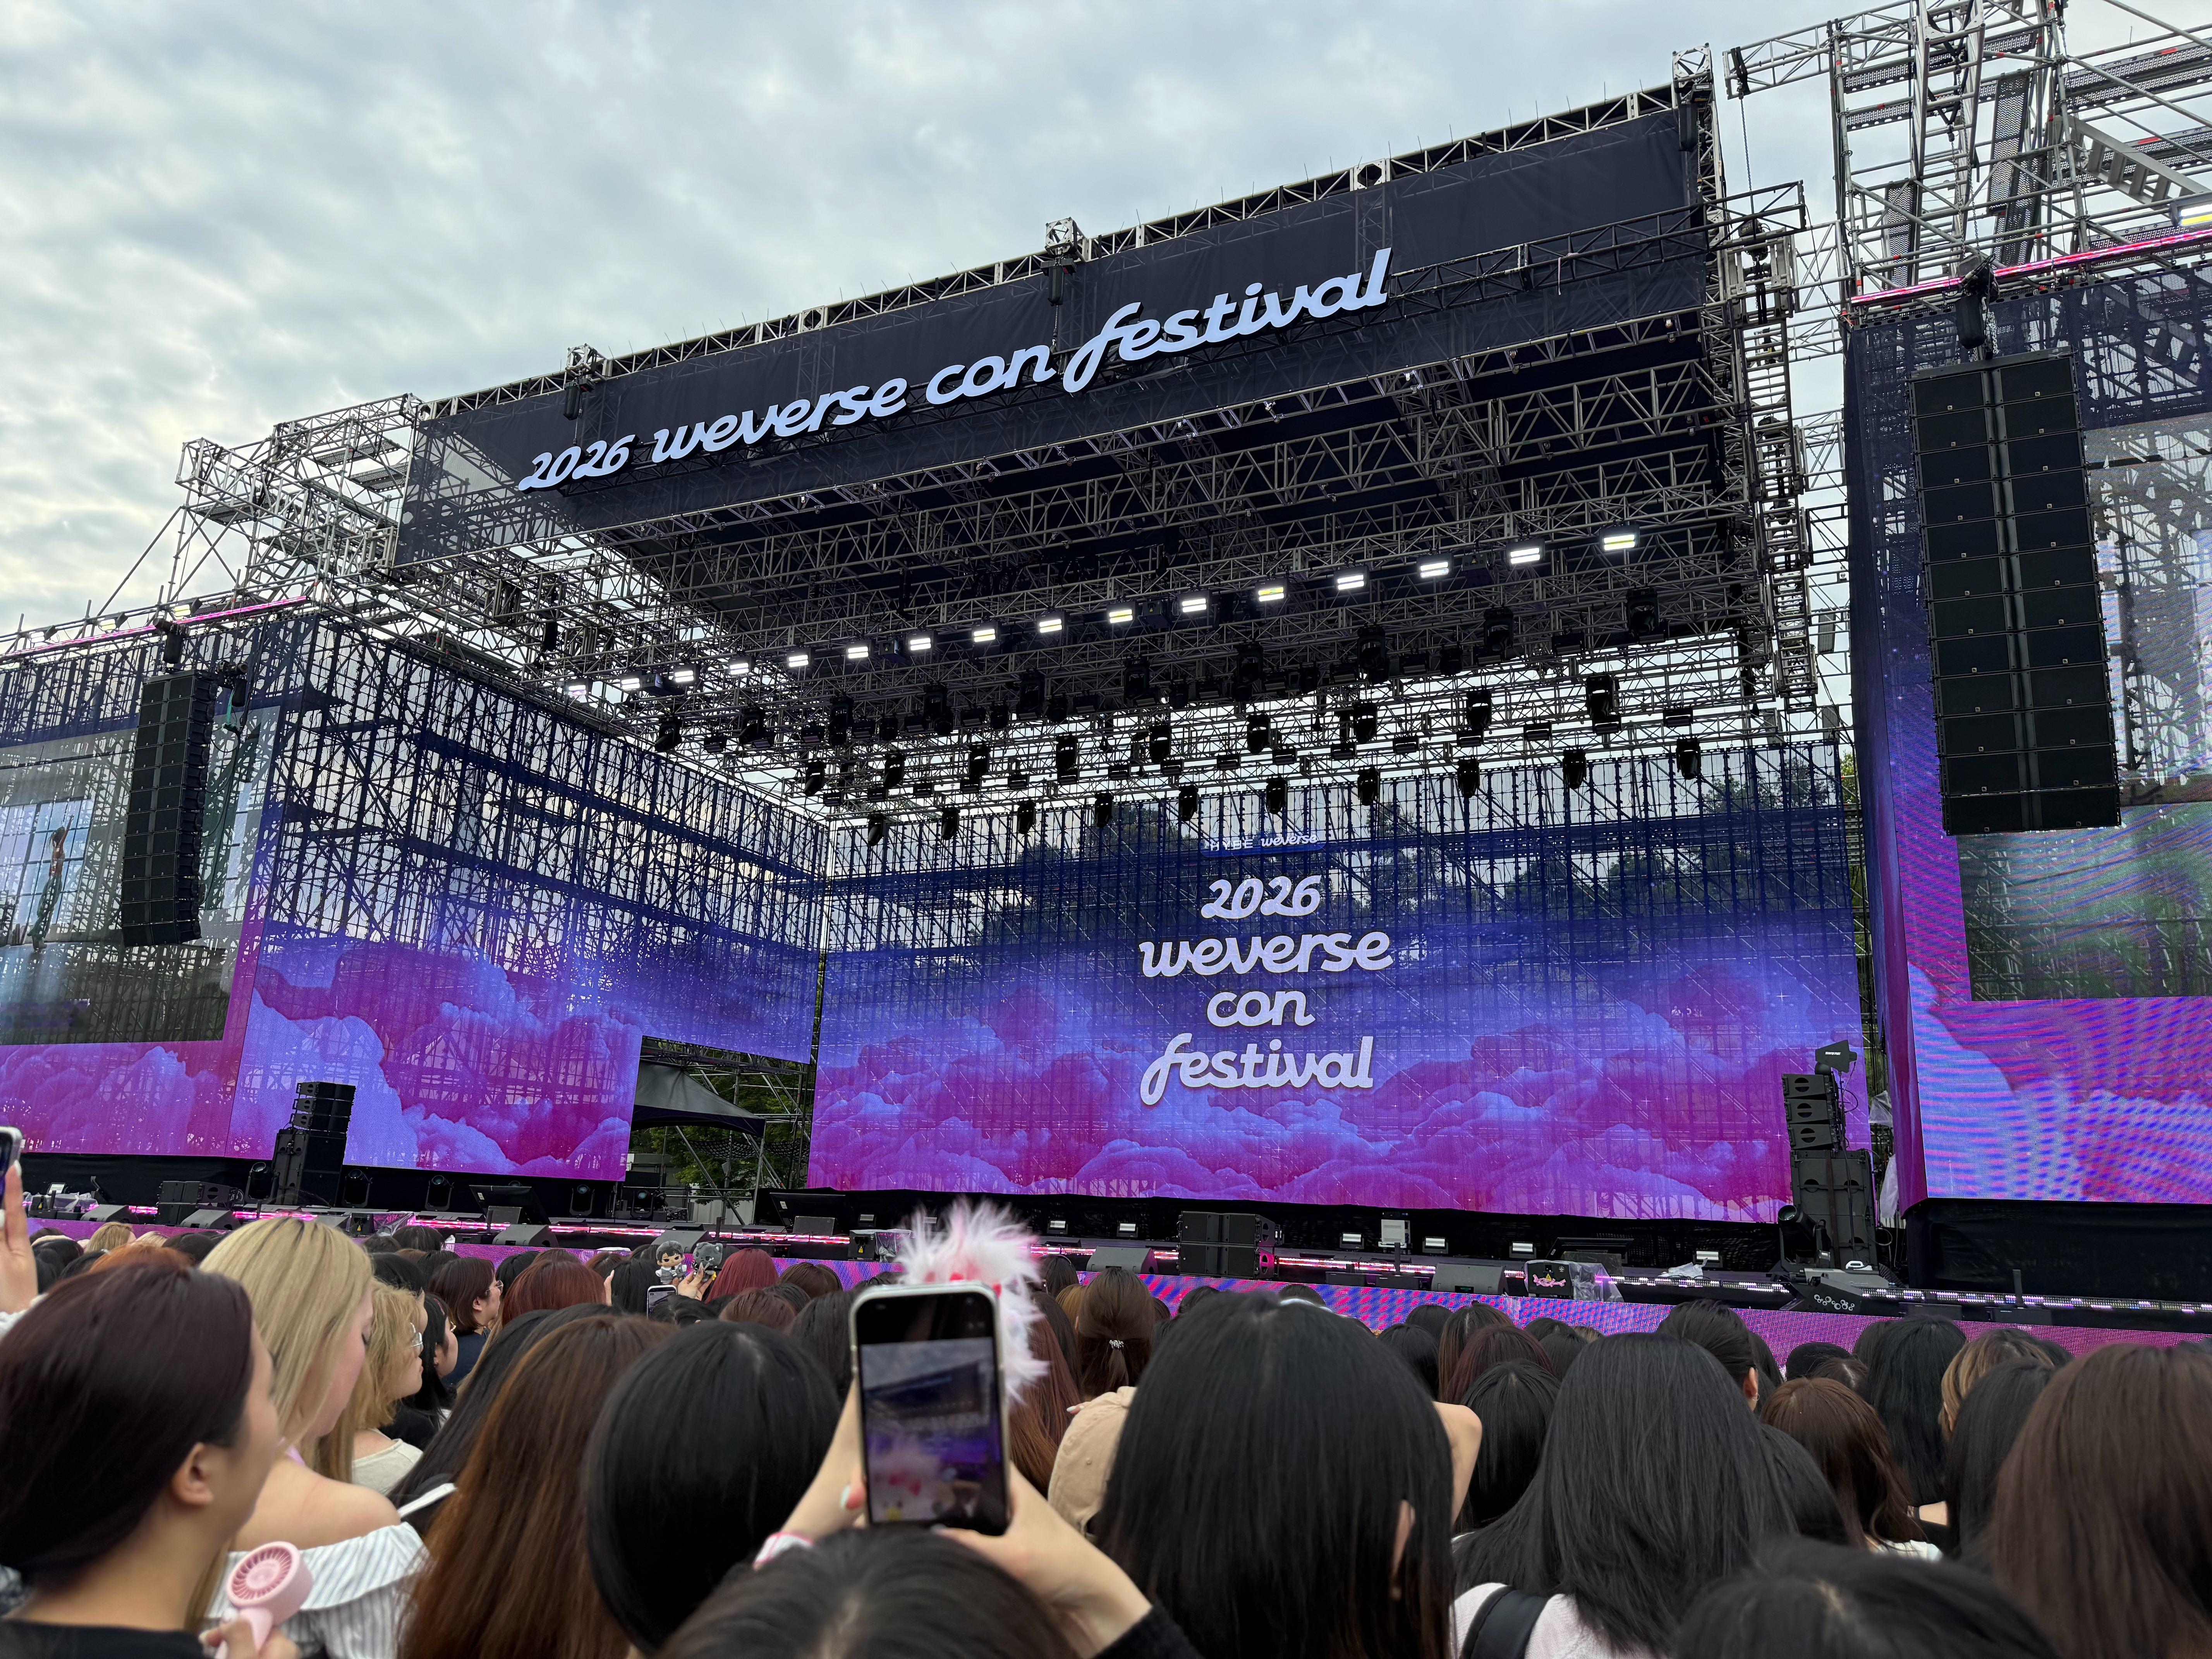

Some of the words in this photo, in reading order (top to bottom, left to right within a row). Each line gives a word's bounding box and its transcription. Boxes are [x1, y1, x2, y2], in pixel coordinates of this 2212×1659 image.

[518, 434, 635, 491] 2026
[651, 378, 908, 463] weverse
[926, 345, 1057, 405] con
[1062, 247, 1392, 393] festival
[1209, 839, 1253, 851] HYBE
[1261, 833, 1317, 847] weverse
[1200, 874, 1322, 919] 2026
[1138, 931, 1394, 977] weverse
[1207, 990, 1316, 1027] con
[1140, 1032, 1374, 1106] festival
